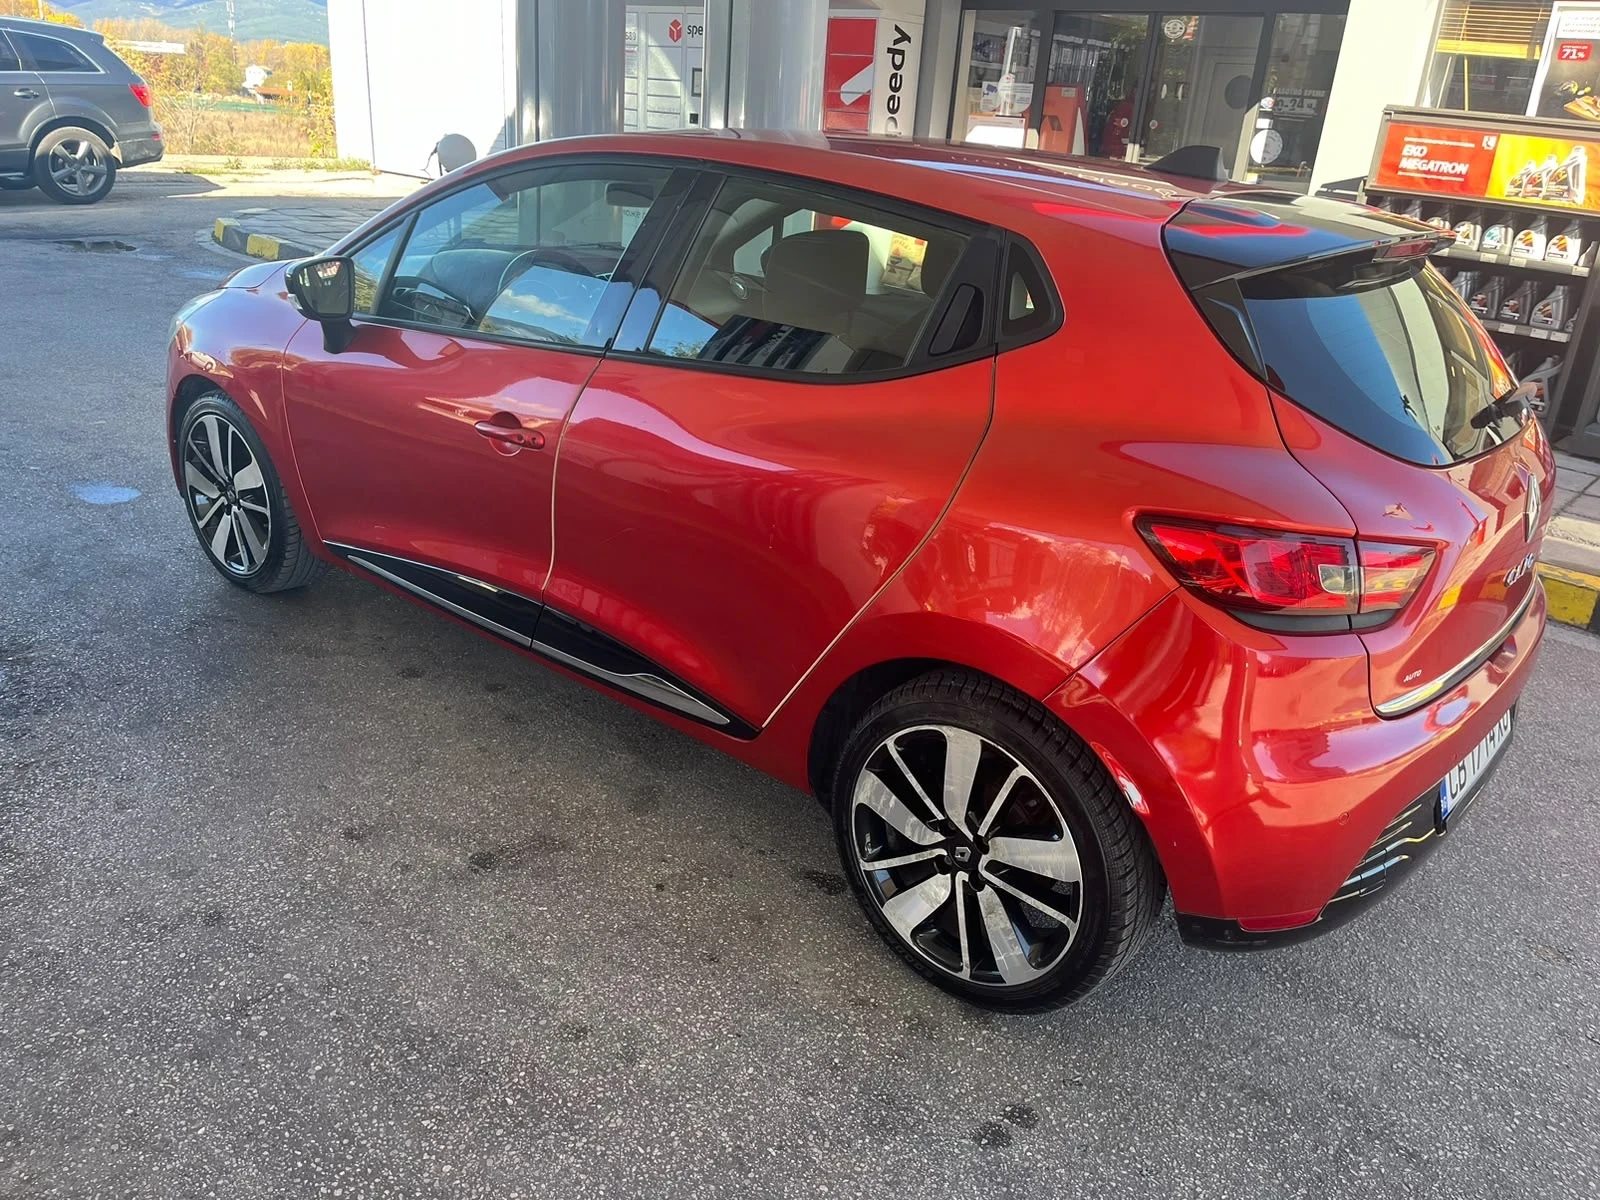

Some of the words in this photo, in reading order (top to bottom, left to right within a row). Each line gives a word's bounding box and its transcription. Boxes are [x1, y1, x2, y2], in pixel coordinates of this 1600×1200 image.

[687, 24, 704, 38] spe
[1561, 48, 1586, 60] 71%
[1402, 143, 1428, 157] EKO
[1398, 157, 1469, 175] MEGATRON
[1403, 669, 1422, 683] AUTO
